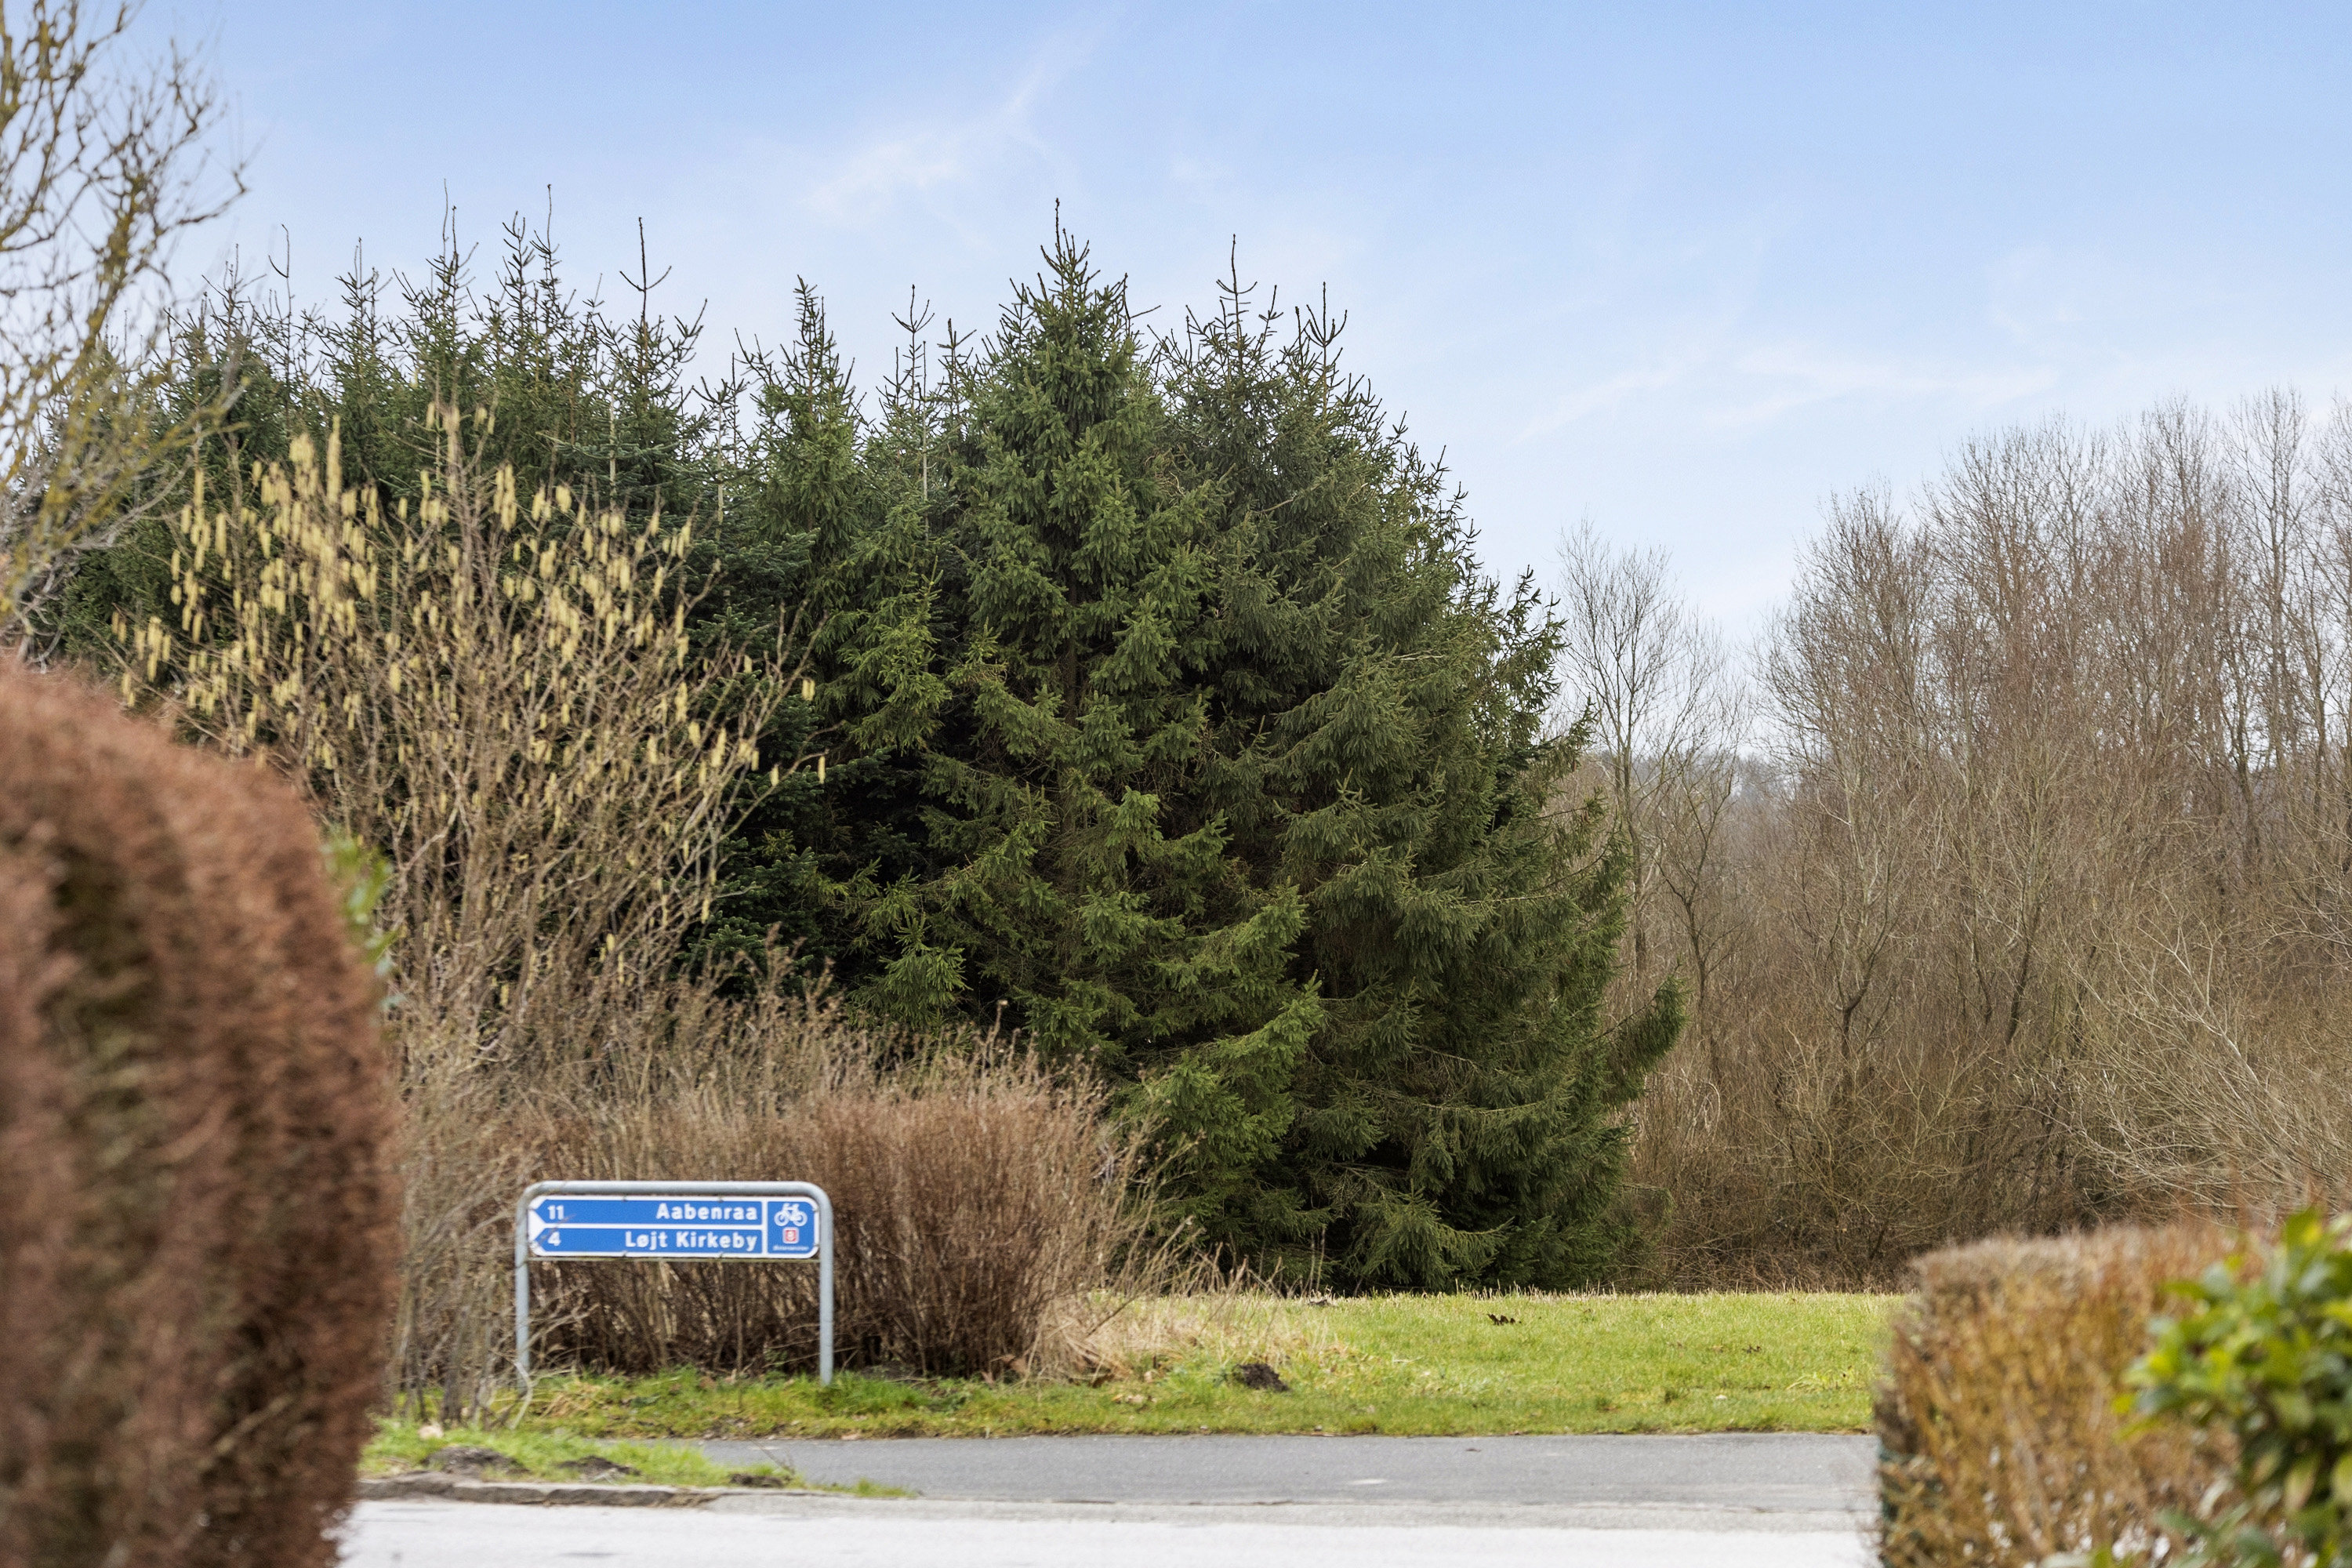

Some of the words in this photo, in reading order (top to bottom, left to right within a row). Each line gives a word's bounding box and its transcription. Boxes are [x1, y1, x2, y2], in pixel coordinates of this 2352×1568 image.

[547, 1205, 564, 1220] 11
[655, 1203, 758, 1220] Aabenraa
[547, 1231, 561, 1247] 4
[625, 1230, 668, 1250] Løjt
[676, 1231, 757, 1252] Kirkeby
